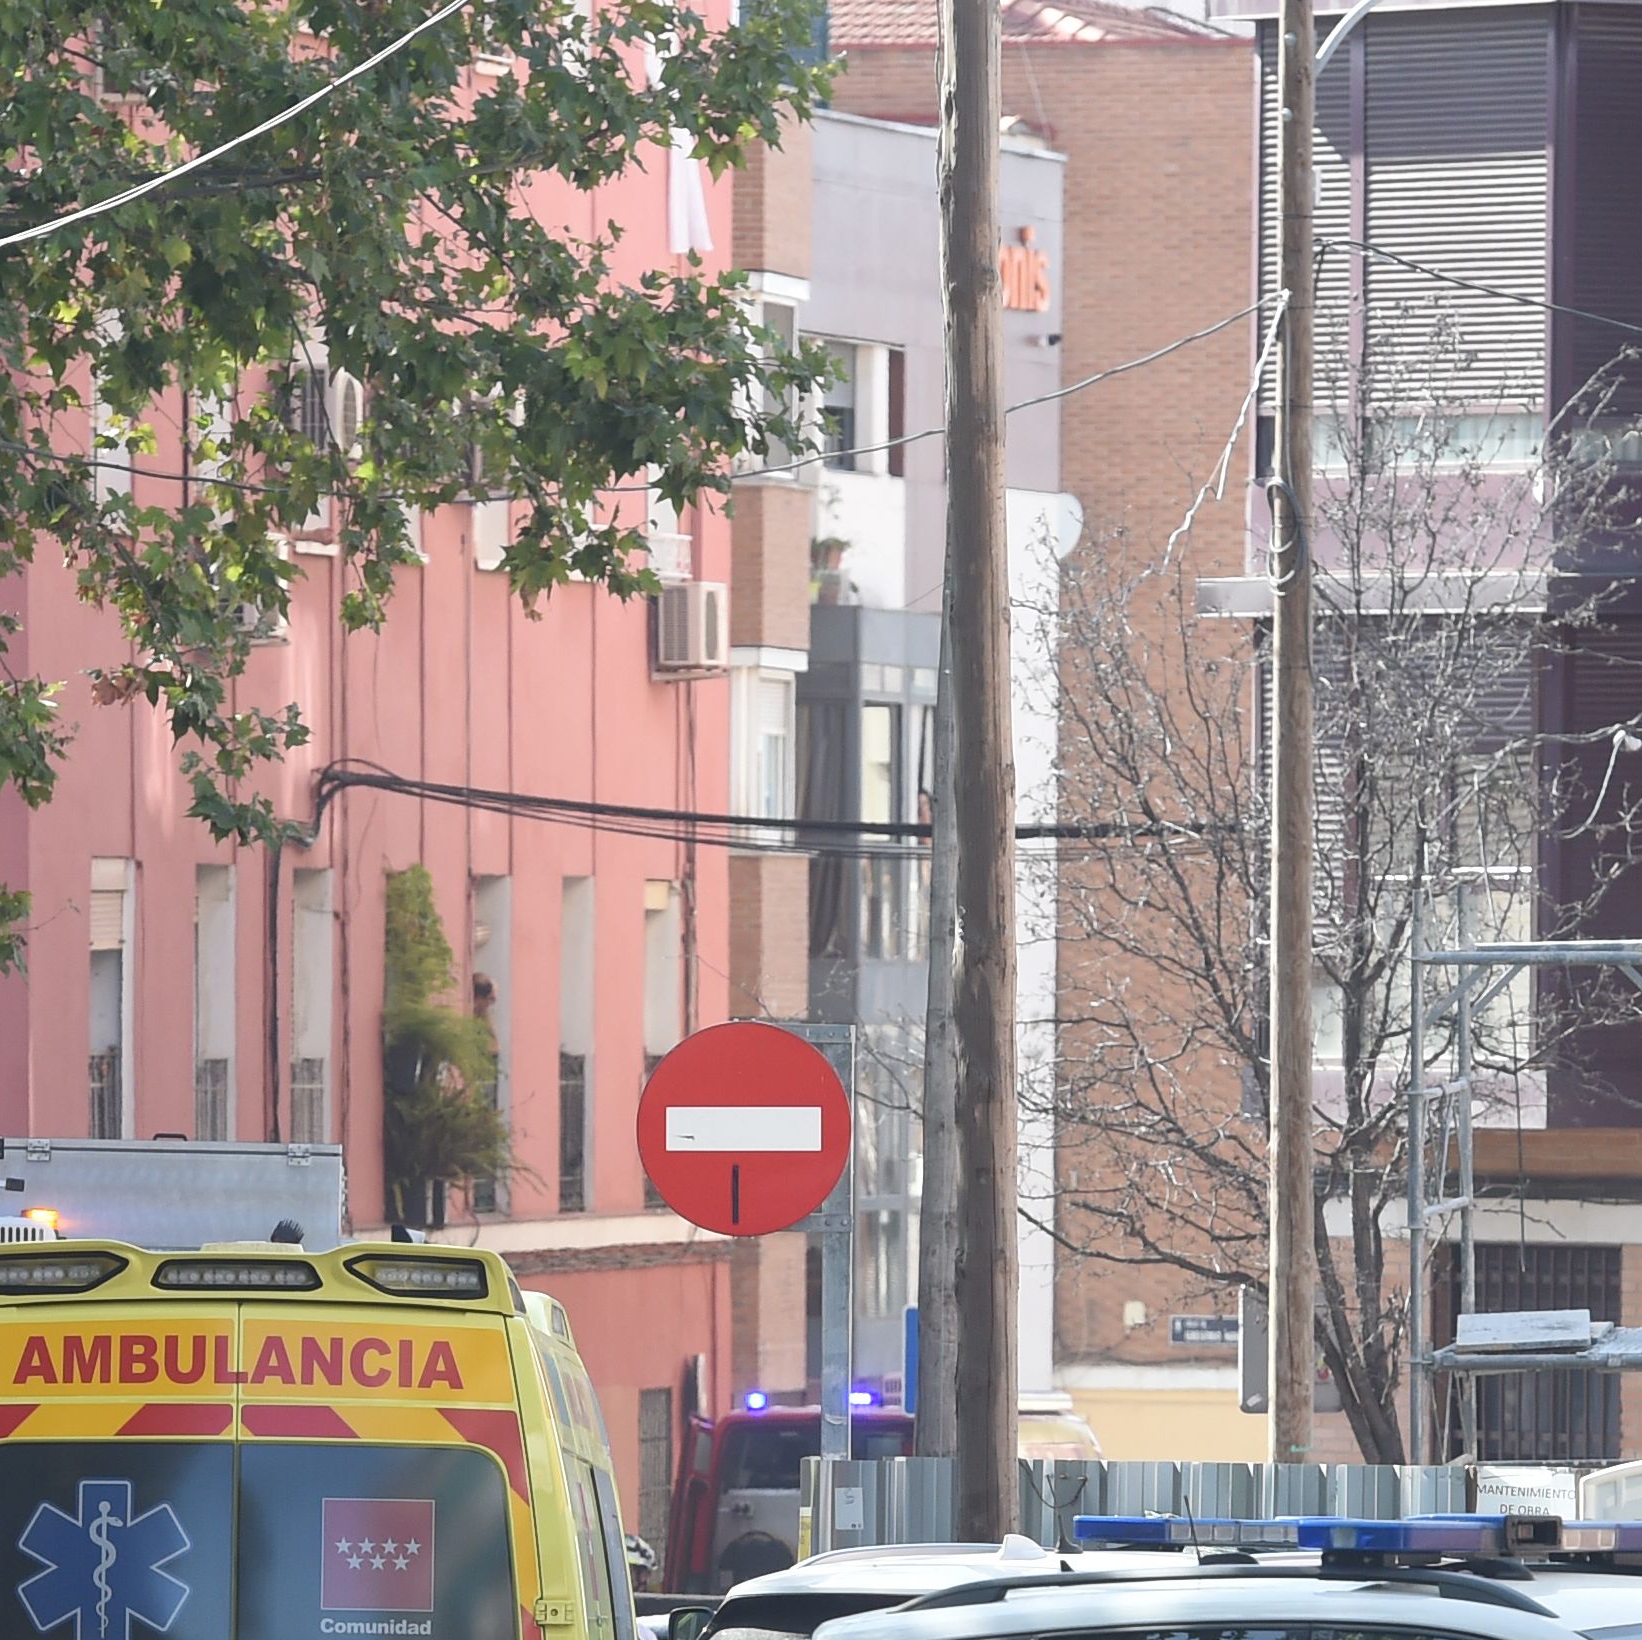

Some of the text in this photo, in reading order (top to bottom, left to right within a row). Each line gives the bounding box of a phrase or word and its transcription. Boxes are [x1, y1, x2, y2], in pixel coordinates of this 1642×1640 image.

[12, 1334, 464, 1390] AMBULANCIA
[1477, 1484, 1576, 1500] MANTENIMIENTO
[1499, 1503, 1514, 1515] DE
[320, 1618, 432, 1635] Comunidad
